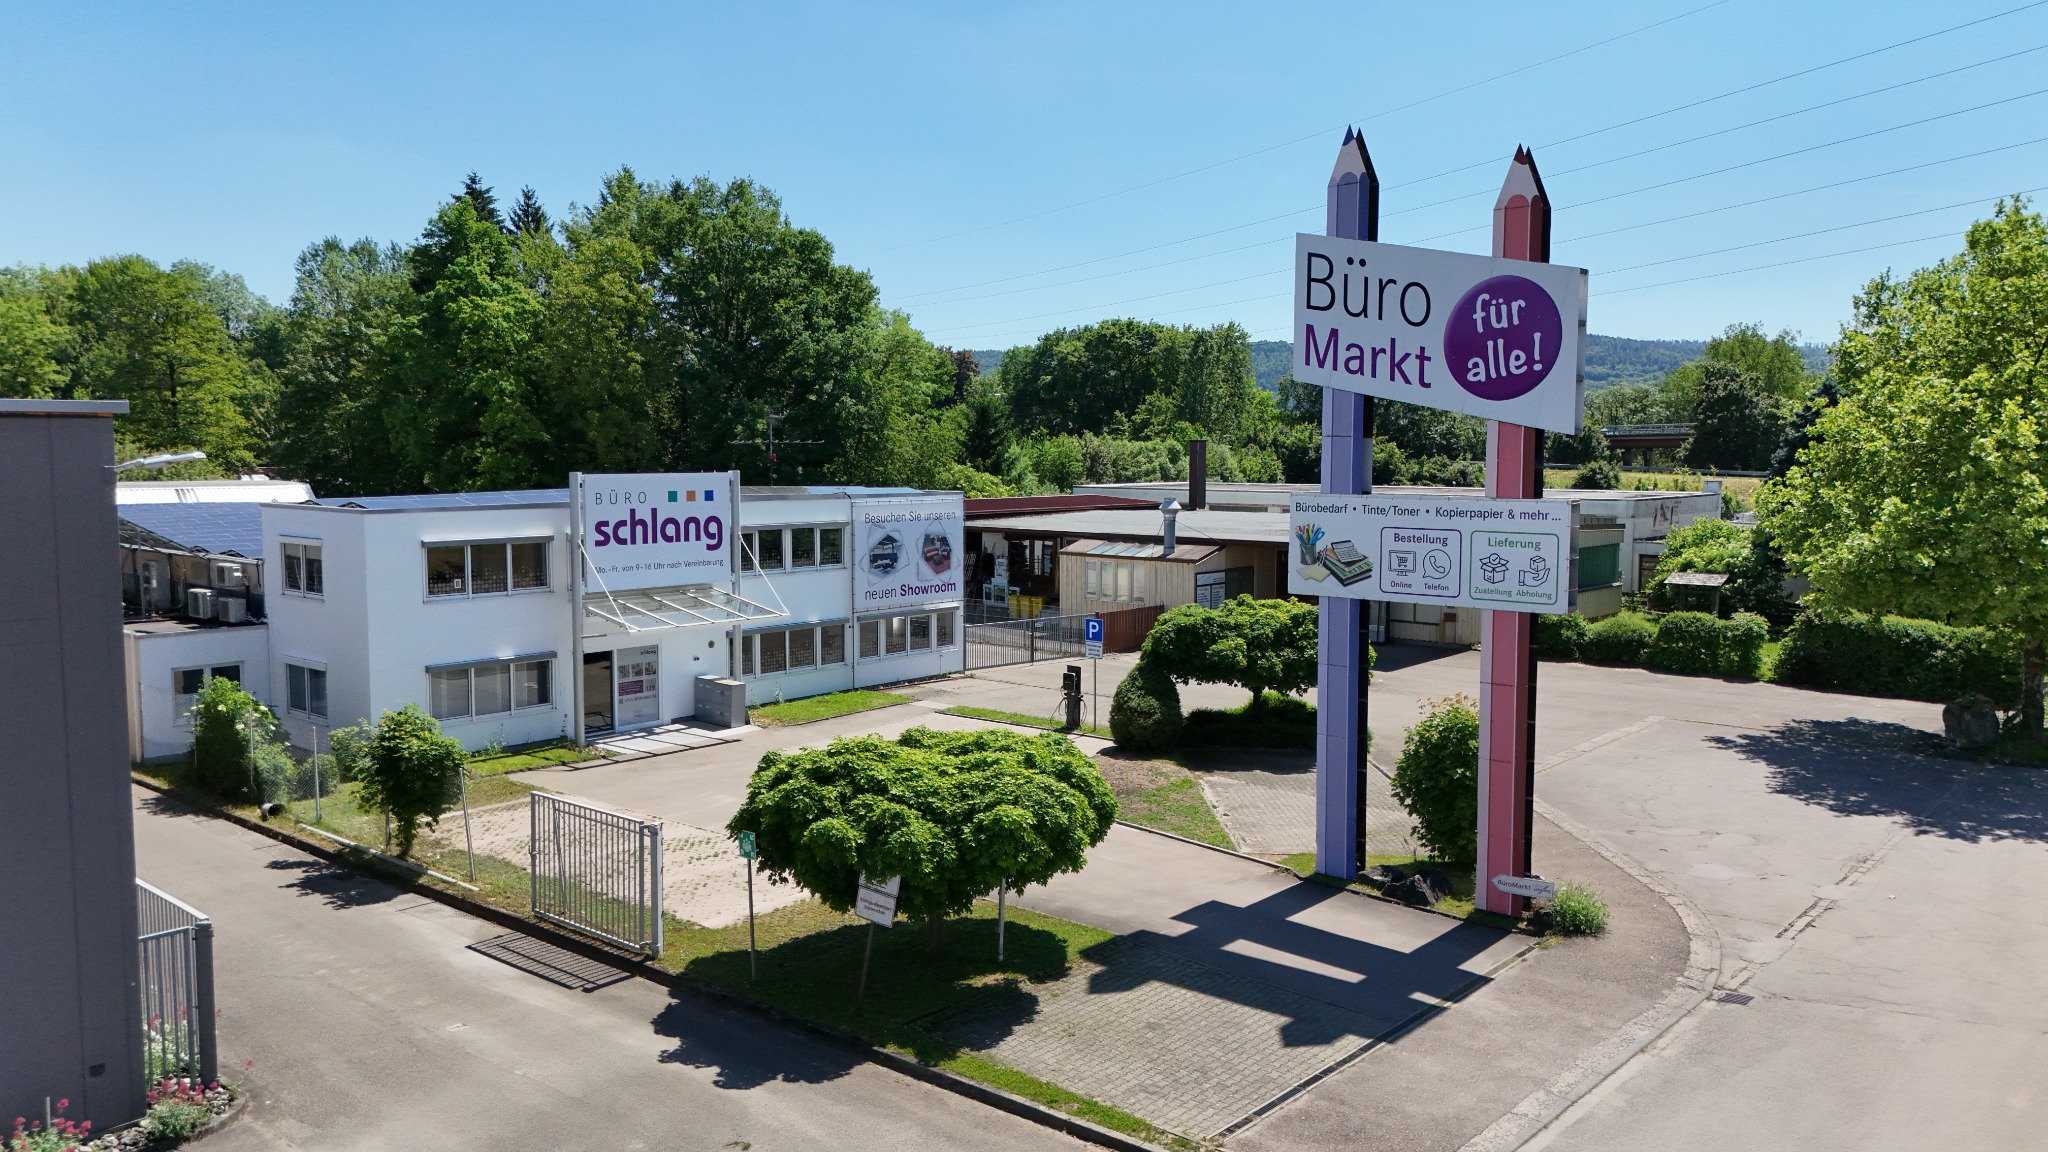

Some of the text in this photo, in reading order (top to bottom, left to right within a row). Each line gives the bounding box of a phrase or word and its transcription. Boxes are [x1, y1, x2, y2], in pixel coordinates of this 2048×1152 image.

[1306, 252, 1431, 327] Büro
[1473, 293, 1526, 333] für
[1304, 323, 1432, 389] Markt
[1466, 332, 1542, 383] alle!
[595, 489, 647, 505] BÜRO
[864, 510, 956, 524] Besuchen Sie unseren
[1295, 502, 1349, 514] Bürobedarf
[1361, 504, 1421, 518] Tinte/Toner
[1435, 506, 1505, 521] Kopierpapier
[1507, 508, 1515, 520] &
[594, 507, 723, 551] schlang
[1393, 532, 1449, 547] Bestellung
[1487, 537, 1541, 551] Lieferung
[653, 562, 666, 570] Uhr
[666, 561, 682, 569] nach
[683, 559, 724, 568] Vereinbarung
[864, 582, 956, 601] neuen Showroom
[1390, 580, 1413, 589] Online
[1424, 583, 1449, 592] Telefon
[1474, 586, 1513, 598] Zustellung
[1516, 589, 1553, 600] Abholung
[1089, 621, 1099, 639] P
[1497, 880, 1531, 890] BüroMarkt
